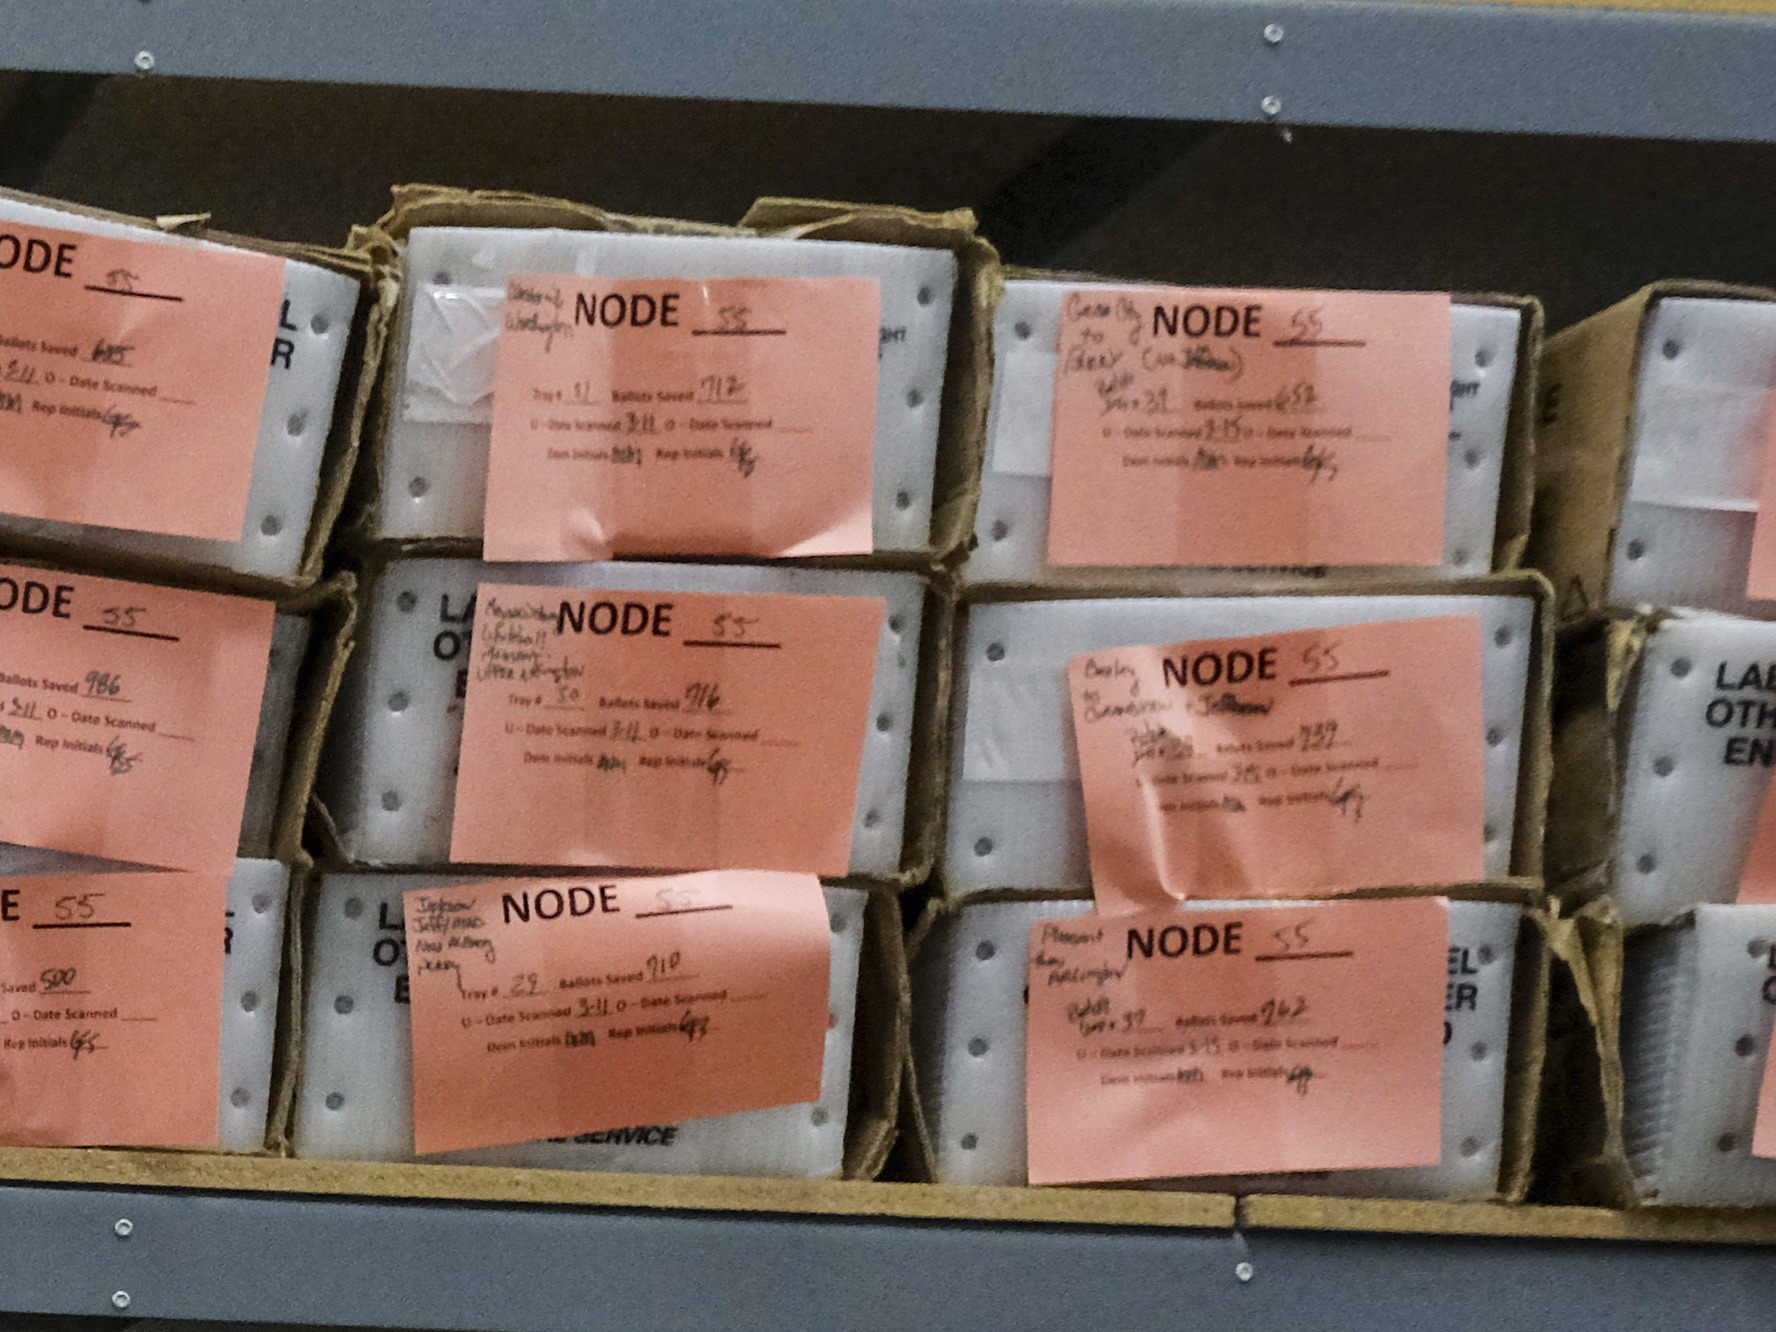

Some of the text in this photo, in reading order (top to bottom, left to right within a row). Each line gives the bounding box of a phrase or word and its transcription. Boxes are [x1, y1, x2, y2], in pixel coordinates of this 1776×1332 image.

[577, 294, 679, 326] NODE
[1154, 307, 1259, 337] NODE
[557, 602, 672, 636] NODE
[53, 896, 100, 922] 55
[503, 887, 619, 923] NODE
[1128, 922, 1315, 958] NODE 55
